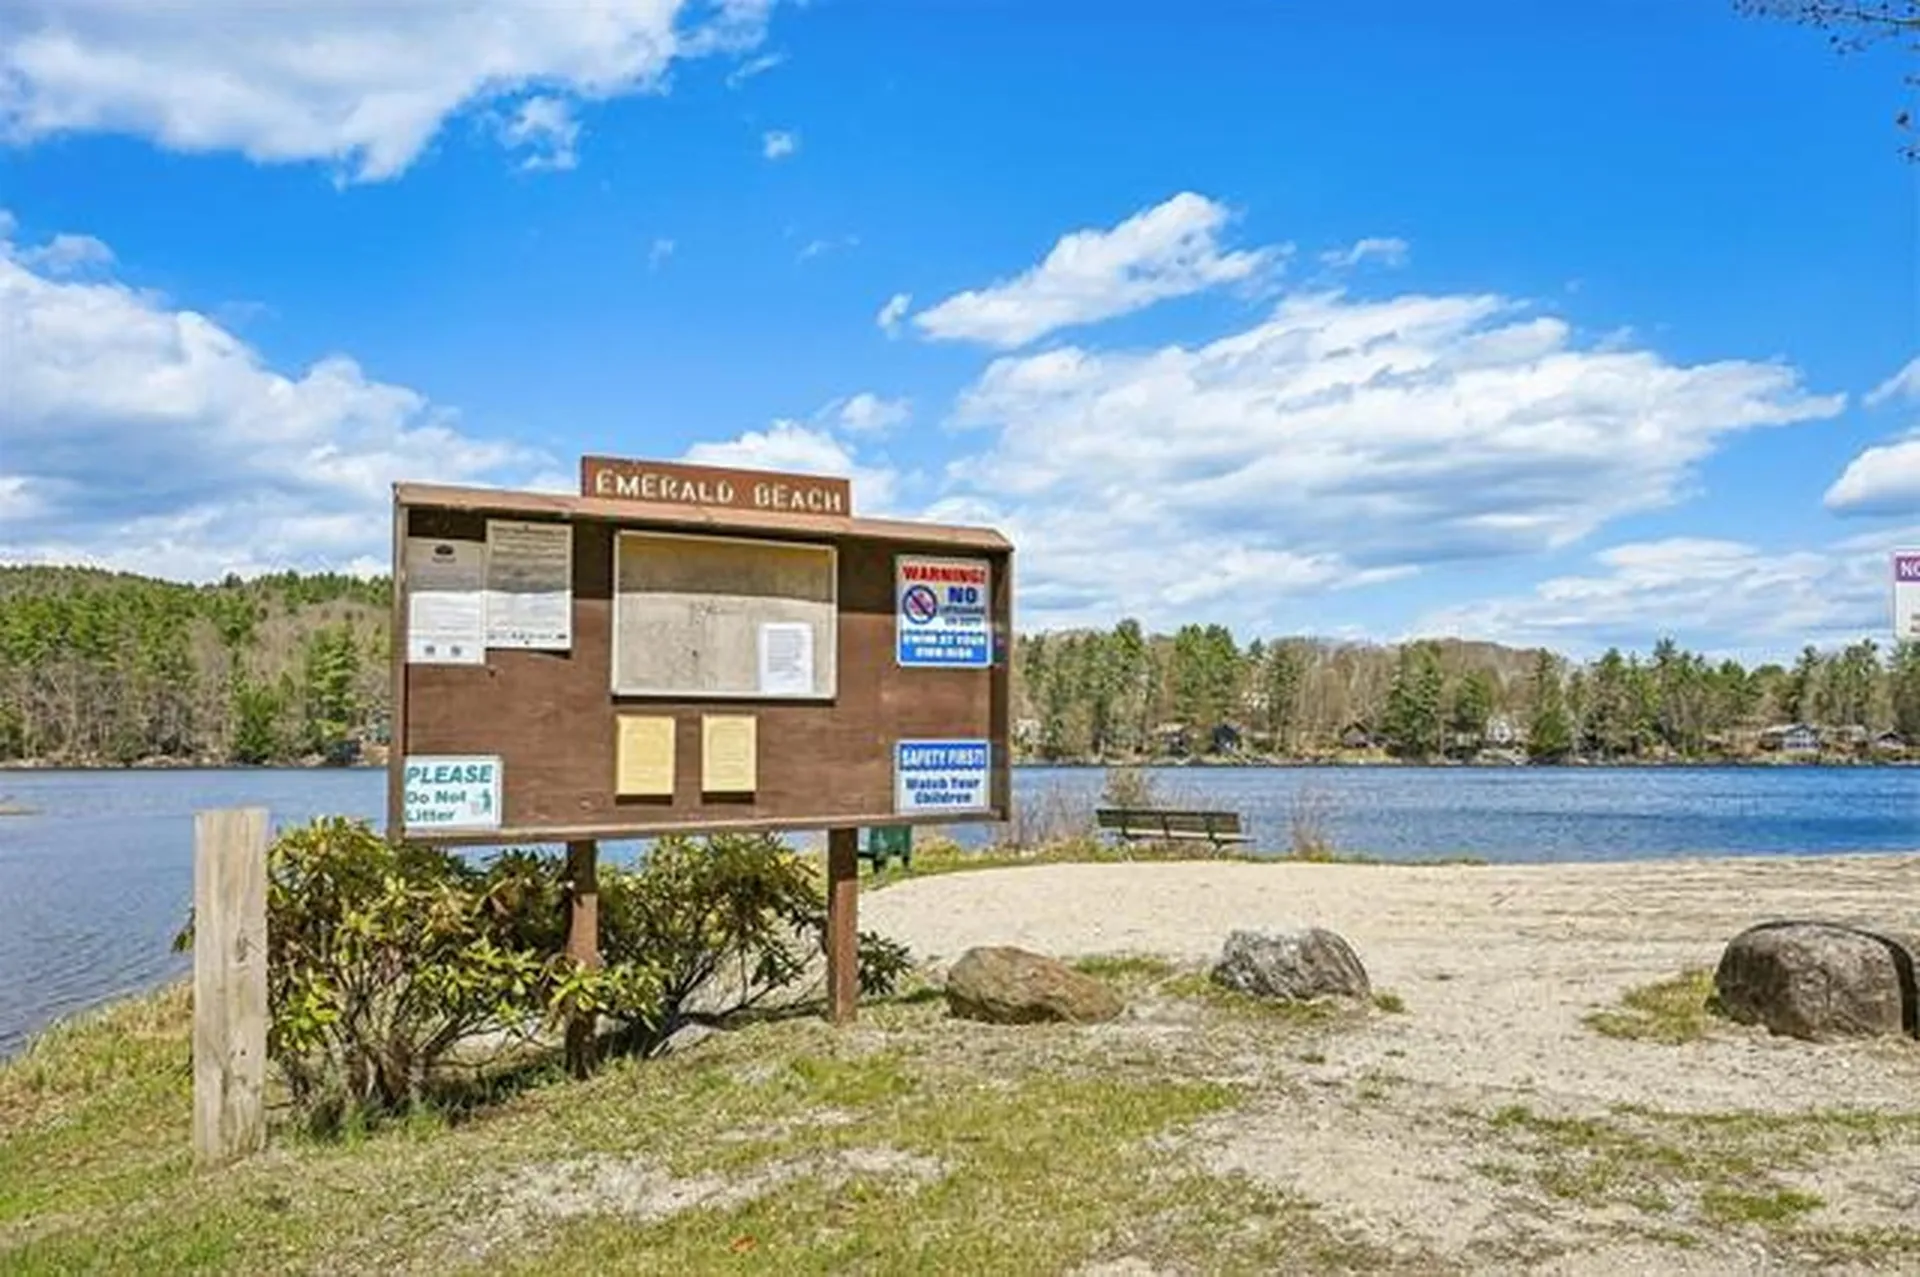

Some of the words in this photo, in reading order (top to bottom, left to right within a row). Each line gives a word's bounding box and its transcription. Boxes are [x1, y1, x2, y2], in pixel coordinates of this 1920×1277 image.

[596, 469, 734, 504] EMERALD
[754, 482, 842, 513] BEACH
[902, 565, 986, 584] WARNING!
[948, 586, 978, 604] NO
[902, 749, 945, 766] SAFETY
[405, 764, 494, 785] PLEASE
[906, 777, 948, 790] Watch
[950, 777, 980, 790] Your
[406, 791, 430, 805] Do
[434, 790, 467, 804] Not
[914, 791, 972, 804] Children
[406, 809, 455, 822] Litter
